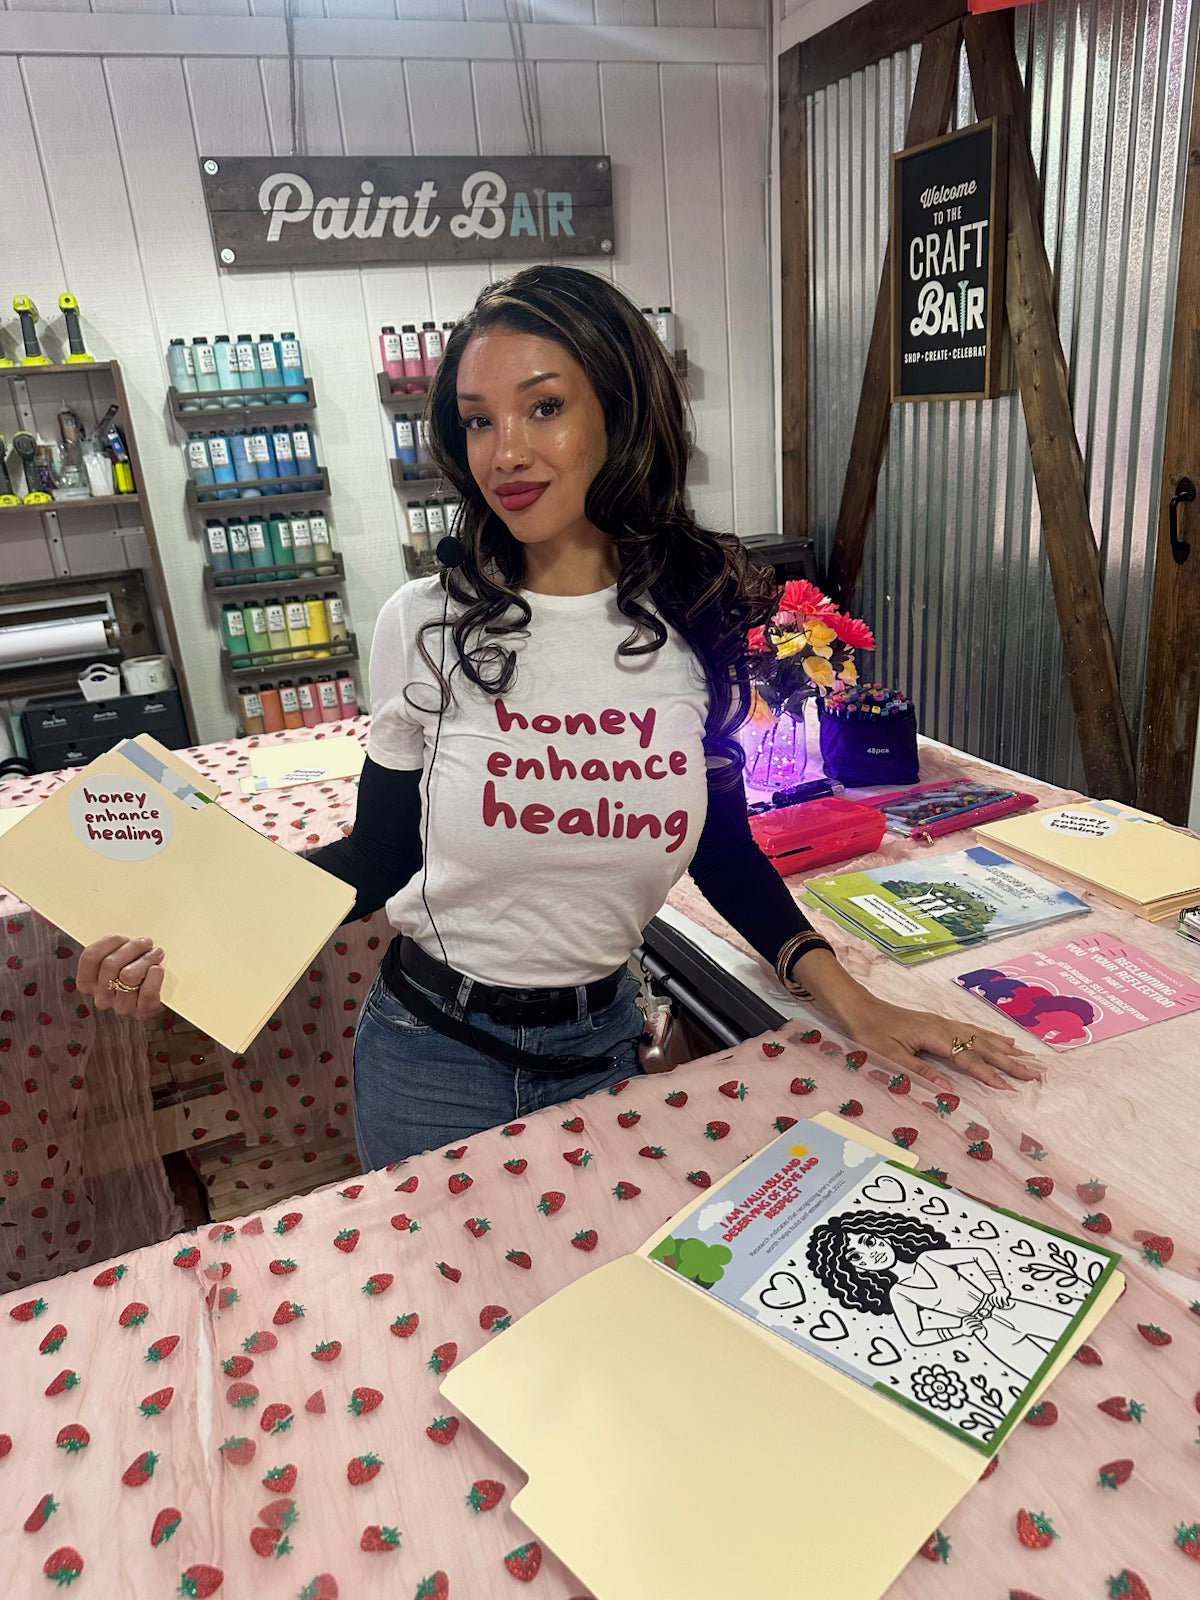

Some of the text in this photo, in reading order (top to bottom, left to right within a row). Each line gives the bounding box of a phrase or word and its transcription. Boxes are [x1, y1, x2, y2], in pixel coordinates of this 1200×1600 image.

[258, 171, 441, 242] Paint
[920, 179, 977, 209] Welcome
[933, 205, 962, 226] TO THE
[909, 219, 989, 281] CRAFT
[494, 698, 657, 749] honey
[487, 745, 688, 782] enhance
[866, 747, 890, 755] 48pcs
[83, 787, 146, 809] honey
[85, 808, 160, 823] enhance
[482, 780, 689, 853] healing
[1050, 822, 1105, 836] healing
[1053, 819, 1110, 830] enhance
[1061, 812, 1107, 825] honey
[87, 823, 163, 845] healing
[1059, 971, 1079, 986] AFTER
[1090, 953, 1176, 1009] YOUR REFLECTION
[1102, 975, 1124, 990] PART
[1113, 955, 1177, 997] RECLAIMING
[722, 1157, 819, 1243] DESERVING OF LOVE AND
[726, 1207, 744, 1224] AM
[739, 1172, 785, 1209] VALUABLE
[781, 1158, 801, 1175] AND
[764, 1186, 802, 1220] RESPECT
